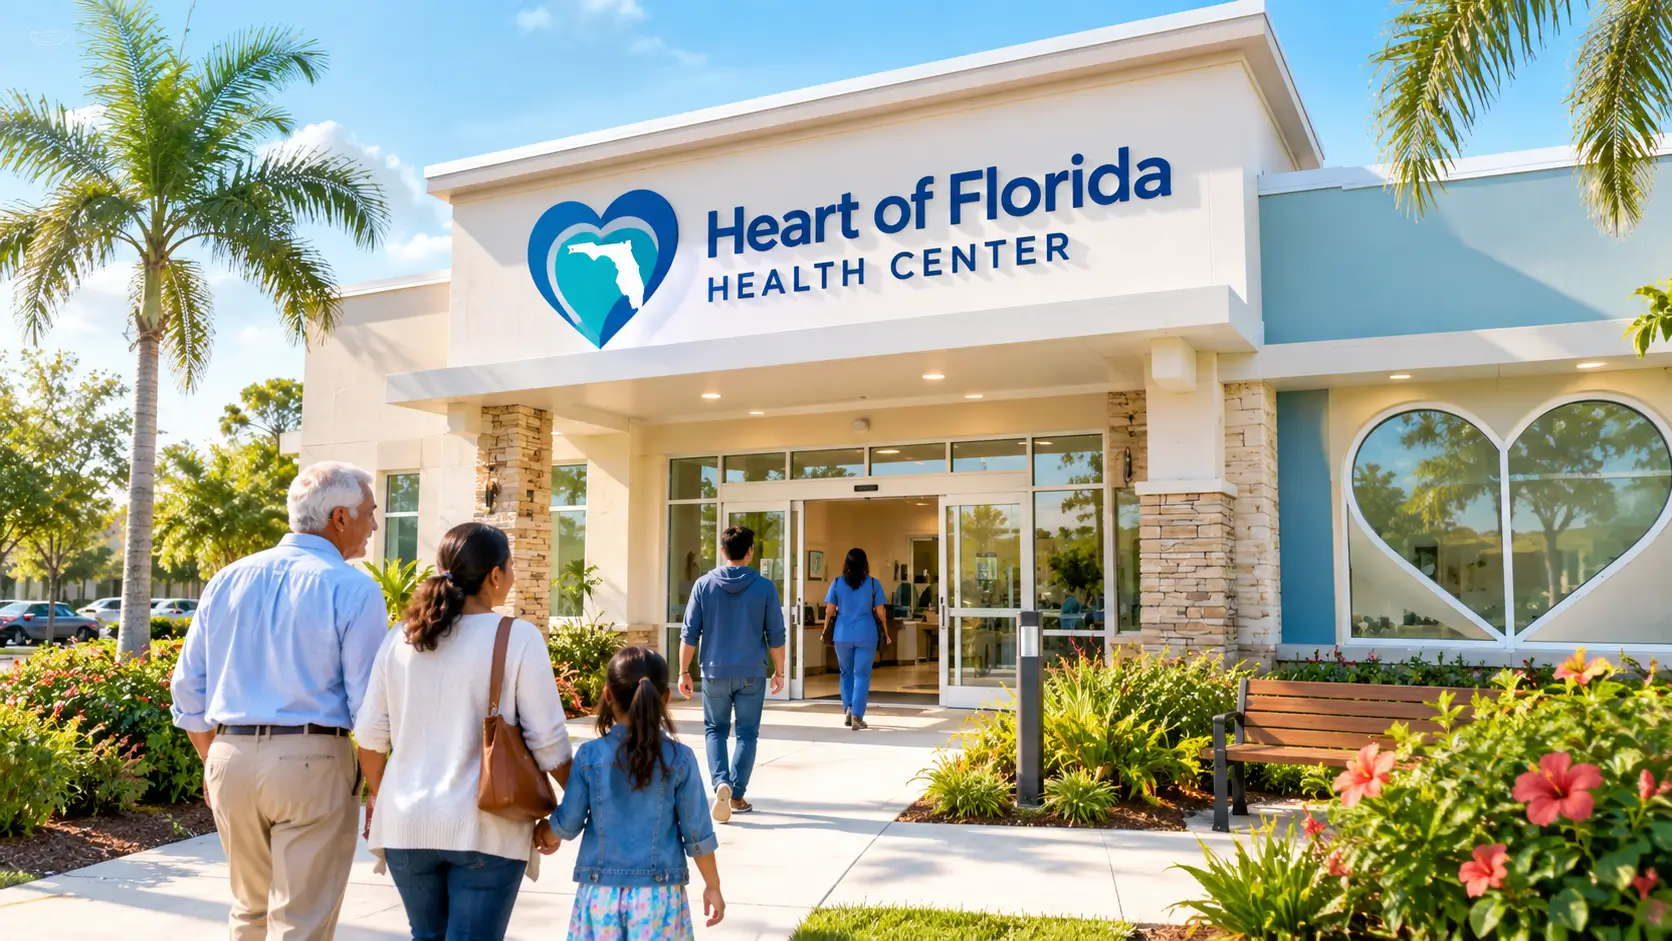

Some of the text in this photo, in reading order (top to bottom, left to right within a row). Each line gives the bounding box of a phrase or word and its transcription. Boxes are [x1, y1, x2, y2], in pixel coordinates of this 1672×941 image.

[707, 146, 1172, 259] Heart of Florida
[708, 232, 1069, 303] HEALTH CENTER
